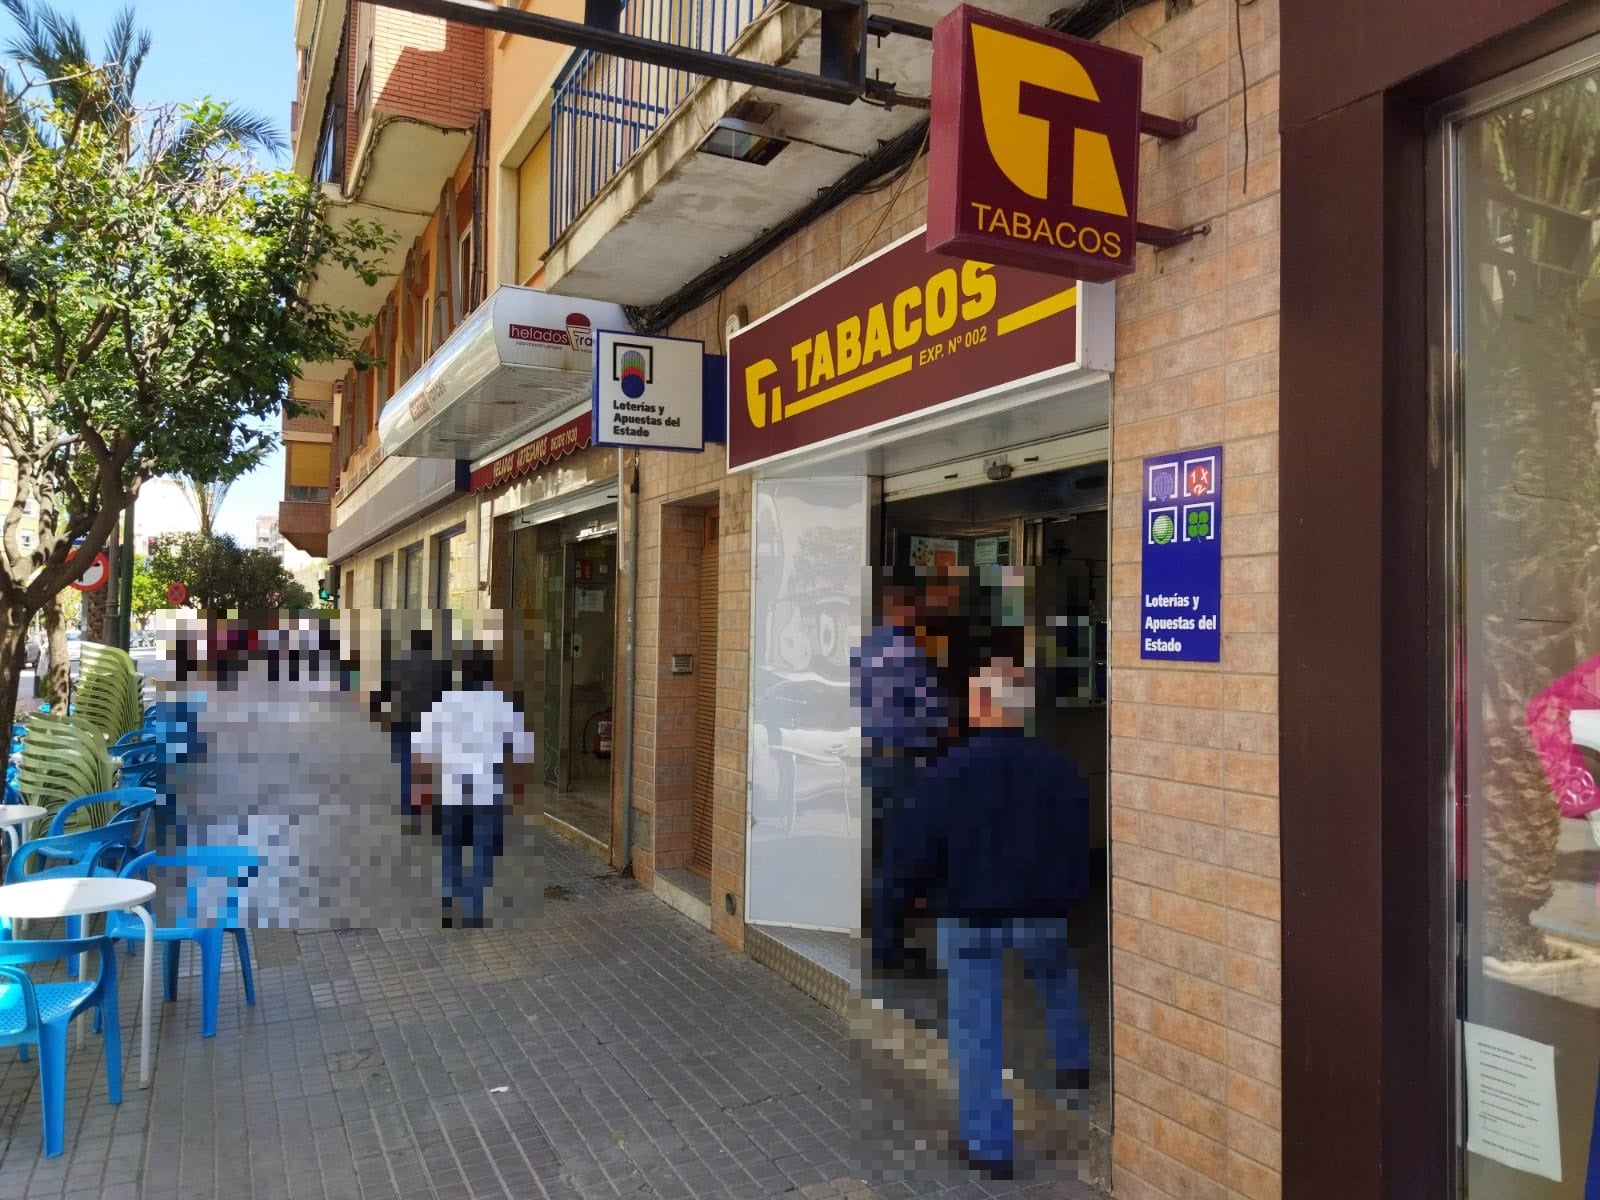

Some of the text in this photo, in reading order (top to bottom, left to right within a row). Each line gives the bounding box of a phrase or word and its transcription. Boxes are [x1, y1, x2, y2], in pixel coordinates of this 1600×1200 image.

[971, 202, 1121, 258] TABACOS
[791, 258, 998, 393] TABACOS
[511, 326, 568, 344] helados
[919, 344, 944, 366] EXP.
[965, 325, 987, 348] 002
[613, 399, 665, 416] Loterías y
[613, 413, 681, 427] Apuestas del
[613, 425, 650, 437] Estado
[1145, 592, 1200, 611] Loterías y
[1144, 615, 1217, 633] Apuestas del
[1144, 637, 1182, 652] Estado
